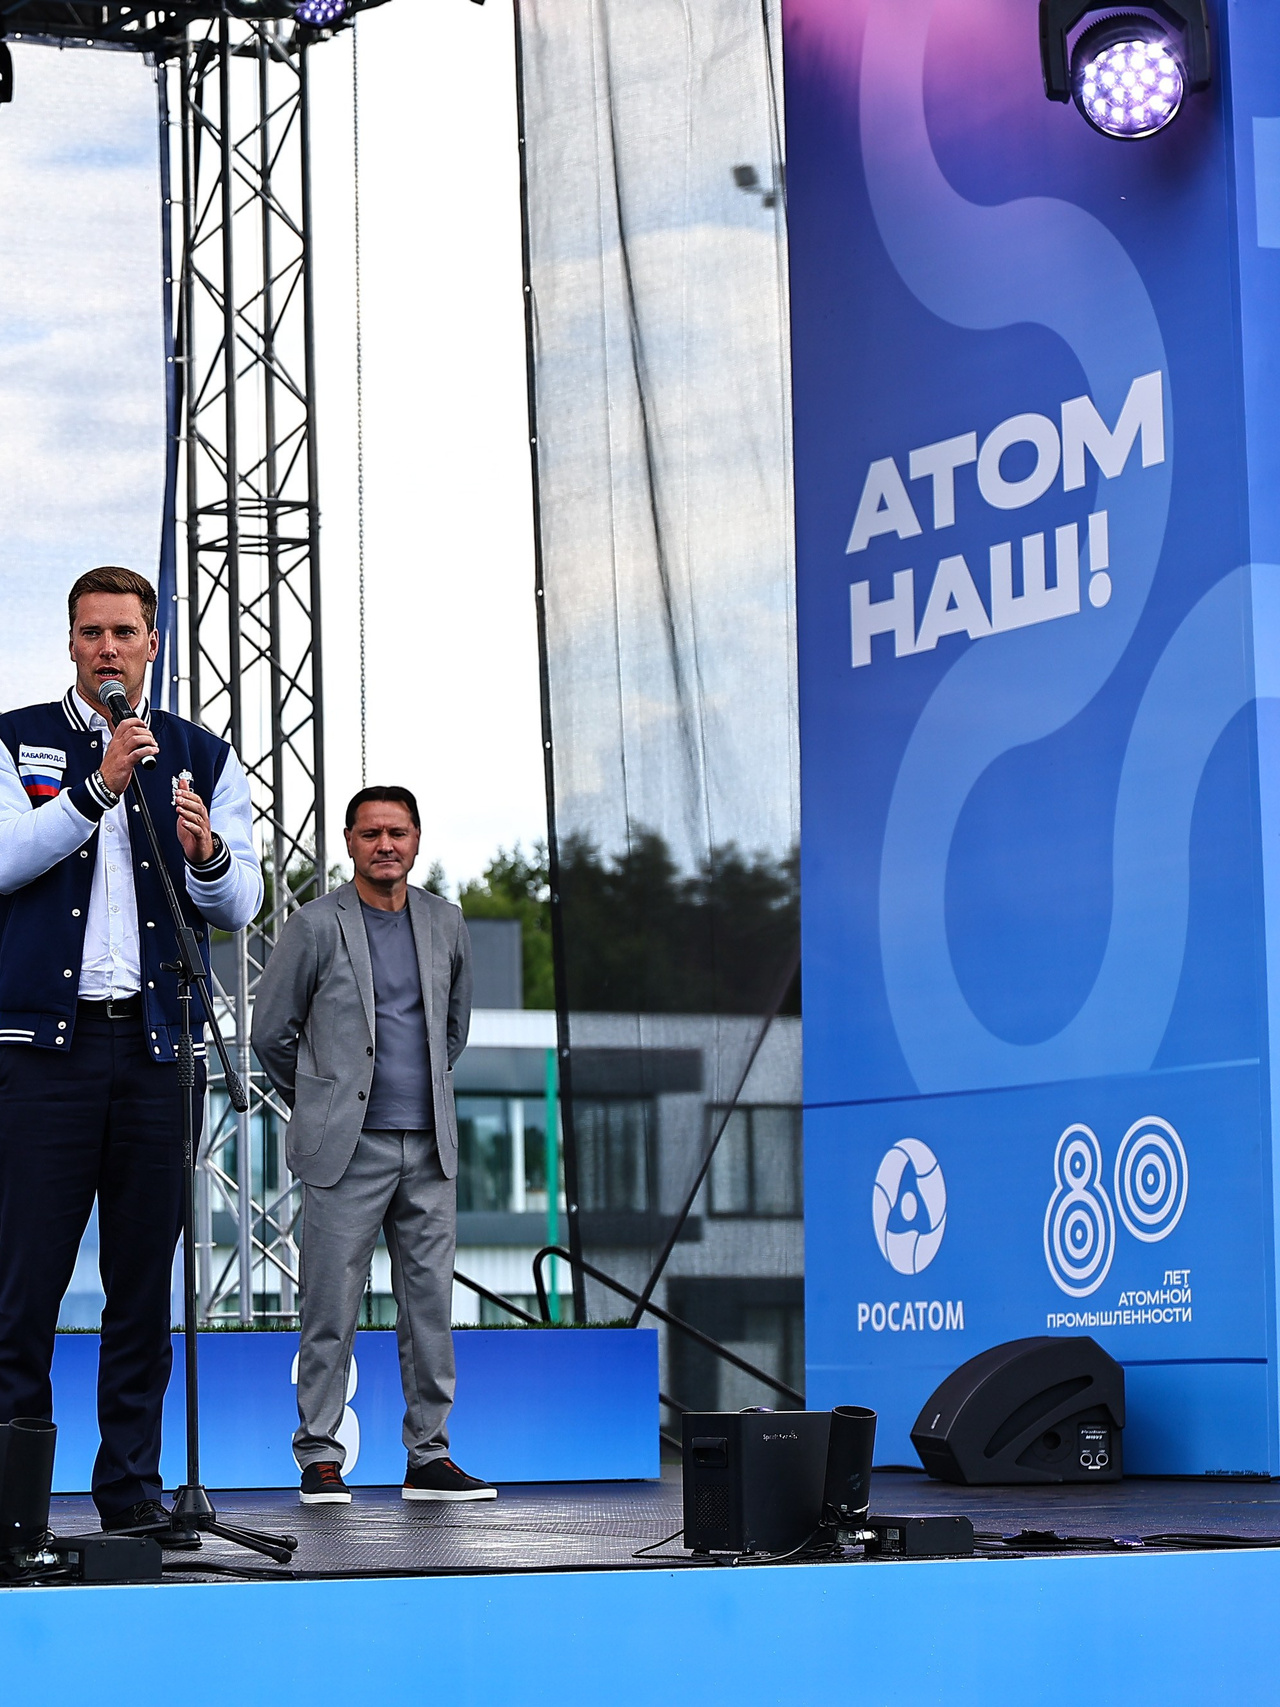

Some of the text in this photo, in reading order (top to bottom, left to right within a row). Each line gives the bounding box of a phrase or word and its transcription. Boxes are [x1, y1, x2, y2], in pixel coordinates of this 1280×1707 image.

[845, 370, 1165, 555] АТОМ
[849, 510, 1113, 668] НАШ!
[1043, 1115, 1189, 1298] 80
[1163, 1269, 1191, 1286] ЛЕТ
[1118, 1283, 1192, 1307] АТОМНОЙ
[857, 1300, 965, 1332] РОСАТОМ
[1046, 1307, 1192, 1328] ПРОМЫШЛЕННОСТИ
